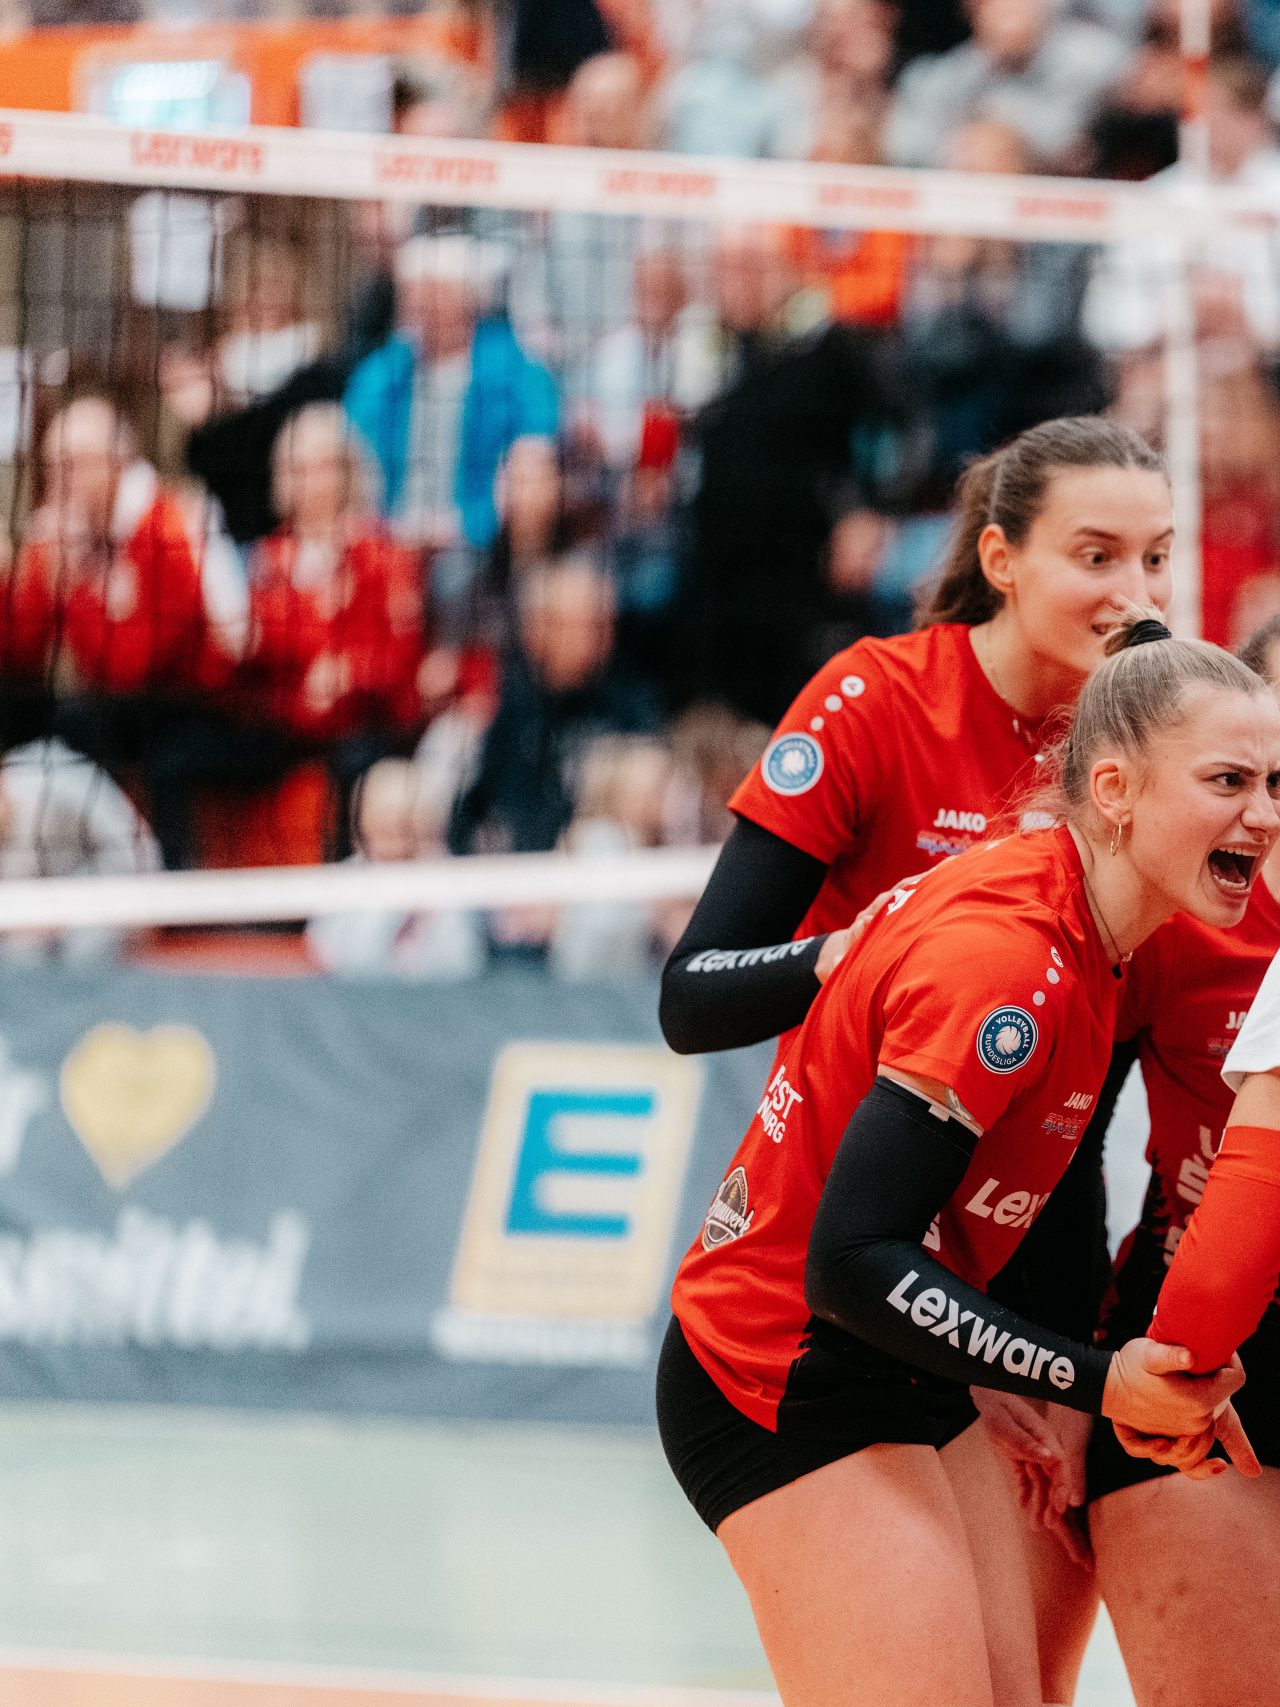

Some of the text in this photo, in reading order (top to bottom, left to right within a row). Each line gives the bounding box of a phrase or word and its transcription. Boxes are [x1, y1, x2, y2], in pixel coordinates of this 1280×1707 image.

[933, 808, 987, 832] JAKO
[995, 1014, 1031, 1049] VOLLEYBALL
[984, 1033, 1018, 1066] BUNDESLIGA
[1063, 1091, 1094, 1111] JAKO
[886, 1269, 1076, 1391] Lexware
